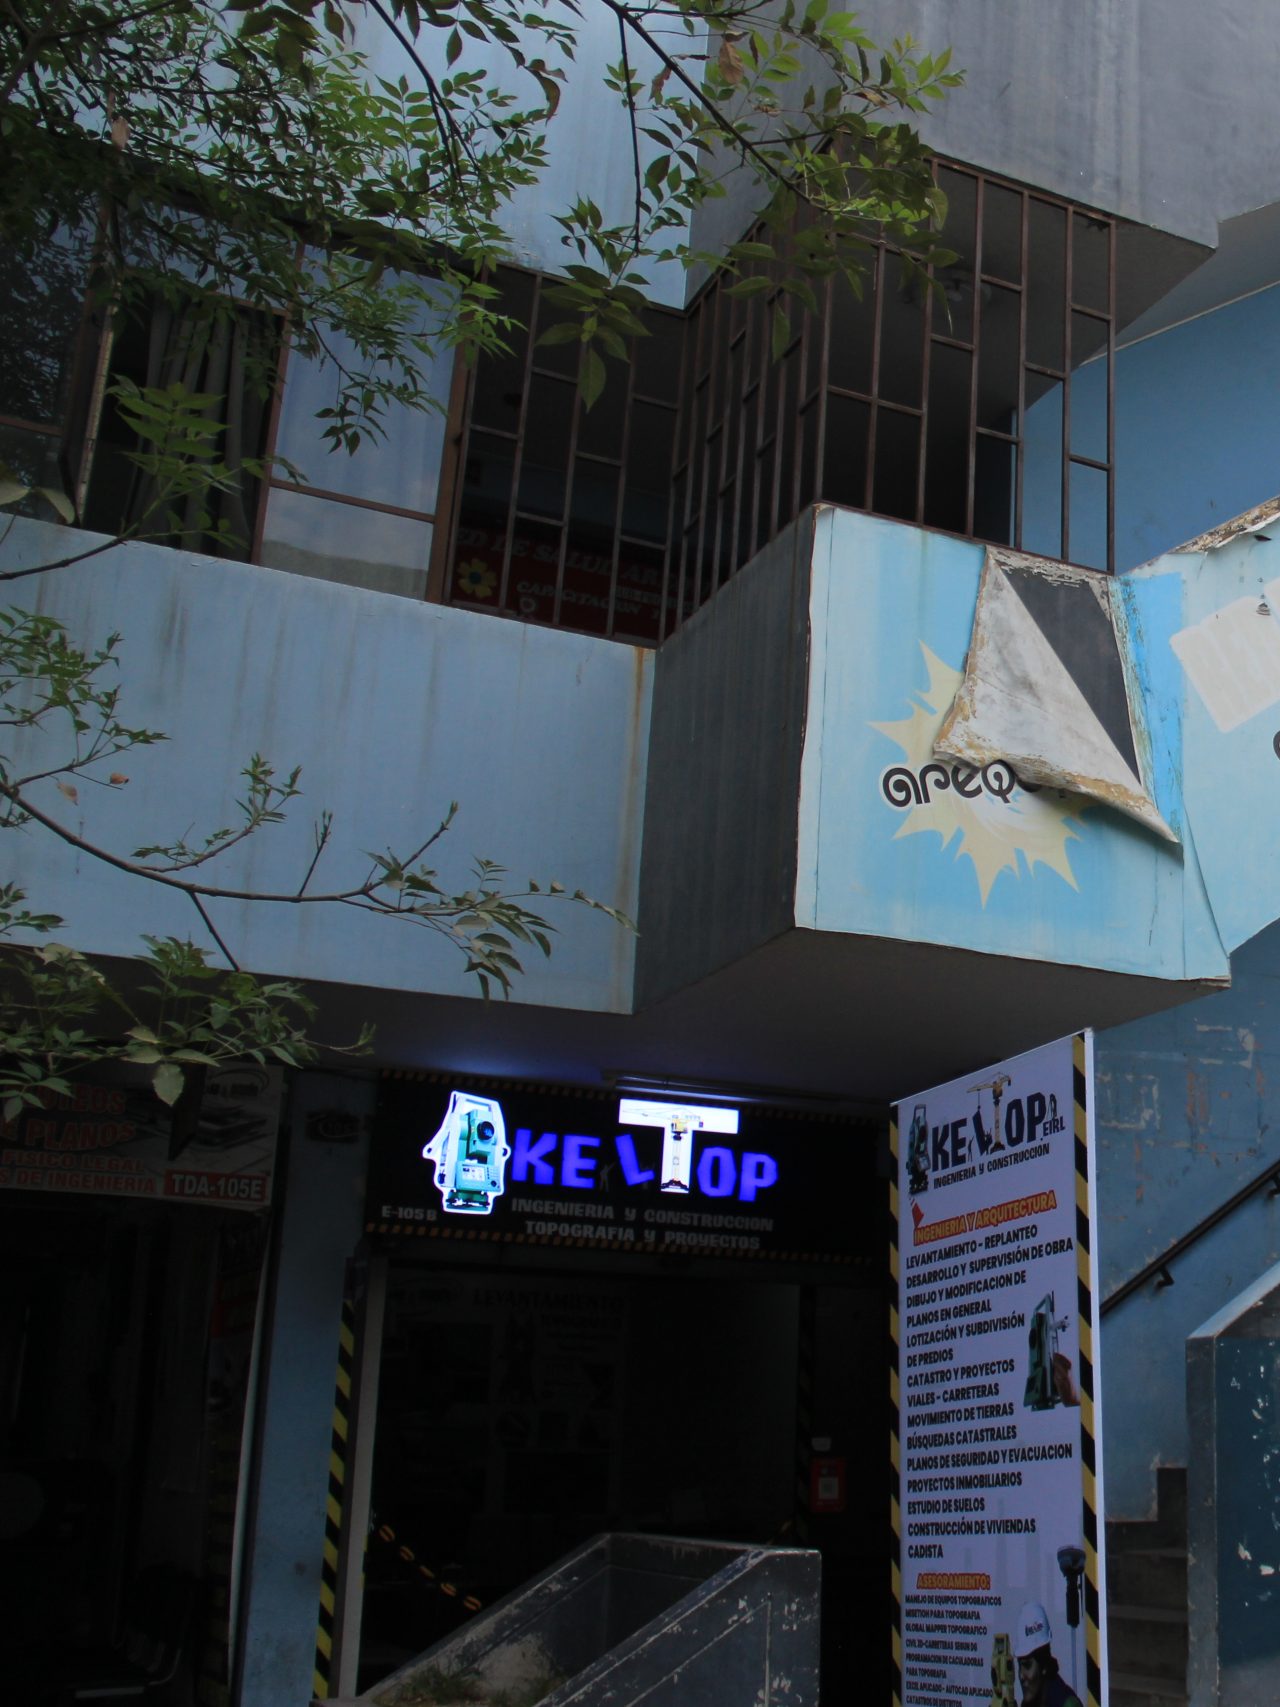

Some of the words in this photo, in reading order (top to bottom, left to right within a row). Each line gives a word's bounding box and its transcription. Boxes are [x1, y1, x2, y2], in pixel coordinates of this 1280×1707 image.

[24, 1118, 137, 1151] PLANOS
[511, 1097, 780, 1203] KELTOP
[80, 1153, 146, 1175] LEGAL
[17, 1168, 43, 1186] DE
[48, 1171, 157, 1195] INGENIERIA
[172, 1173, 263, 1199] TDA-105E
[933, 1165, 977, 1190] INGENIERIA
[511, 1196, 616, 1222] INGENIERIA
[643, 1208, 775, 1233] CONSTRUCCION
[914, 1214, 967, 1246] INGENIERIA
[974, 1191, 1057, 1230] ARQUITECTURA
[524, 1219, 636, 1244] TOPOGRAFIA
[663, 1228, 761, 1250] PROYECTOS
[906, 1239, 977, 1270] LEVANTAMIENTO
[984, 1224, 1038, 1249] REPLANTEO
[906, 1265, 959, 1290] DESARROLLO
[959, 1262, 966, 1277] Y
[969, 1244, 1030, 1275] SUPERVISIÓN
[1031, 1245, 1043, 1260] DE
[1044, 1237, 1074, 1258] OBRA
[906, 1289, 937, 1309] DIBUJO
[938, 1287, 945, 1302] Y
[1013, 1269, 1027, 1285] DE
[906, 1310, 939, 1329] PLANOS
[940, 1306, 952, 1322] EN
[952, 1299, 992, 1321] GENERAL
[906, 1323, 957, 1348] LOTIZACIÓN
[958, 1322, 965, 1337] Y
[965, 1311, 1025, 1337] SUBDIVISIÓN
[906, 1354, 918, 1369] DE
[918, 1348, 954, 1367] PREDIOS
[907, 1368, 952, 1388] CATASTRO
[953, 1366, 960, 1381] Y
[960, 1358, 1015, 1379] PROYECTOS
[907, 1390, 936, 1408] VIALES
[942, 1382, 1000, 1404] CARRETERAS
[907, 1408, 963, 1428] MOVIMIENTO
[963, 1407, 976, 1421] DE
[976, 1402, 1015, 1419] TIERRAS
[906, 1430, 956, 1451] BÚSQUEDAS
[956, 1425, 1018, 1445] CATASTRALES
[907, 1455, 939, 1471] PLANOS
[939, 1454, 951, 1468] DE
[951, 1450, 1000, 1468] SEGURIDAD
[1000, 1449, 1008, 1464] Y
[1008, 1443, 1073, 1463] EVACUACION
[907, 1477, 956, 1493] PROYECTOS
[956, 1471, 1022, 1490] INMOBILIARIOS
[907, 1500, 942, 1515] ESTUDIO
[942, 1499, 953, 1513] DE
[953, 1497, 985, 1513] SUELOS
[907, 1516, 974, 1537] CONSTRUCCIÓN
[974, 1520, 986, 1535] DE
[987, 1518, 1037, 1534] VIVIENDAS
[907, 1544, 944, 1559] CADISTA
[917, 1572, 991, 1590] ASESORAMIENTO:
[905, 1594, 928, 1604] MANEJO
[927, 1595, 935, 1604] DE
[934, 1595, 958, 1606] EQUIPOS
[930, 1609, 945, 1619] PARA
[905, 1623, 925, 1633] GLOBAL
[925, 1623, 948, 1634] MAPPER
[905, 1667, 918, 1677] PARA
[919, 1681, 942, 1692] APLICADO
[969, 1686, 993, 1698] APLICADO
